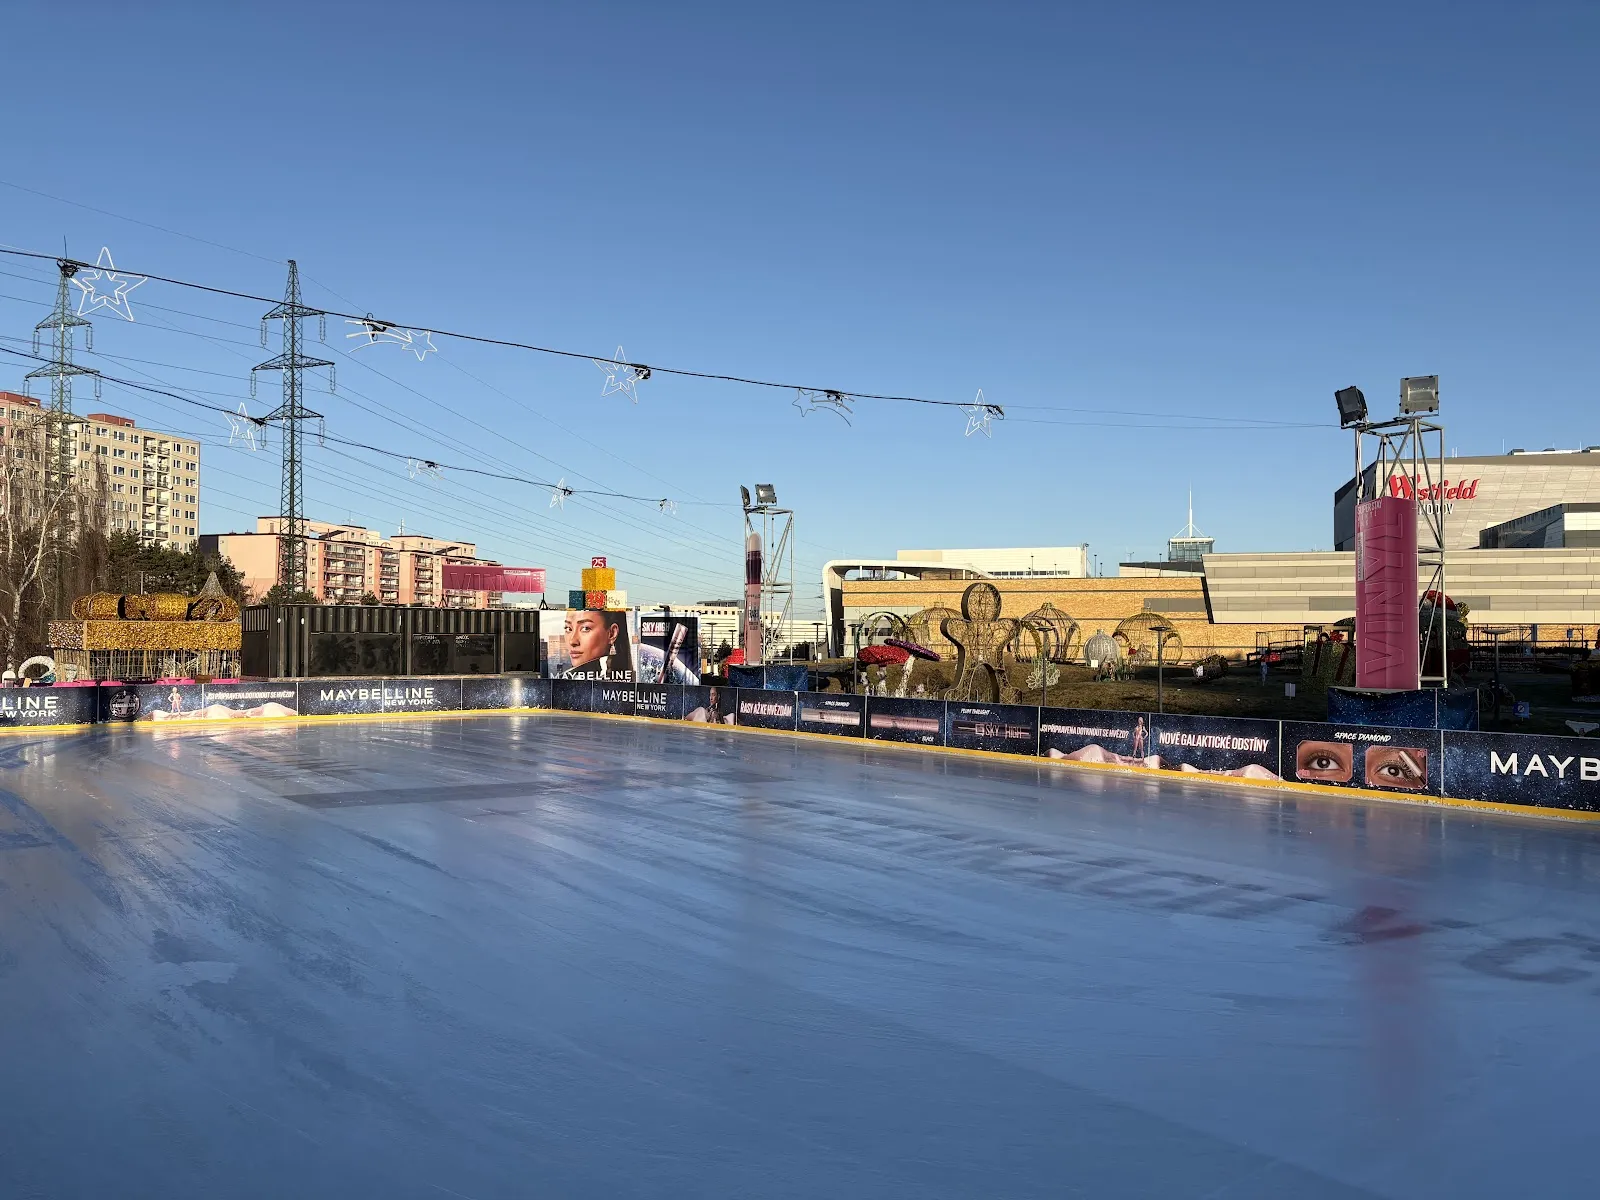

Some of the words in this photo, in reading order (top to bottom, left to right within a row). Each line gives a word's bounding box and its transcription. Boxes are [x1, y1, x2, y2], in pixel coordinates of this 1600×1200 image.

[592, 558, 604, 568] 25
[642, 622, 655, 632] SKY
[655, 622, 670, 632] HIGH
[550, 670, 633, 680] MAYBELLINE
[320, 687, 435, 701] MAYBELLINE
[602, 689, 668, 705] MAYBELLINE
[2, 696, 59, 710] LINE
[407, 698, 435, 706] YORK
[650, 704, 666, 712] YORK
[20, 709, 58, 718] YORK
[1159, 731, 1180, 745] NOVÉ
[1180, 733, 1231, 749] GALAKTICKÉ
[1231, 736, 1269, 752] ODSTÍNY
[1334, 732, 1357, 741] SPACE
[1358, 733, 1392, 742] DIAMOND
[1490, 751, 1600, 781] MAYB
